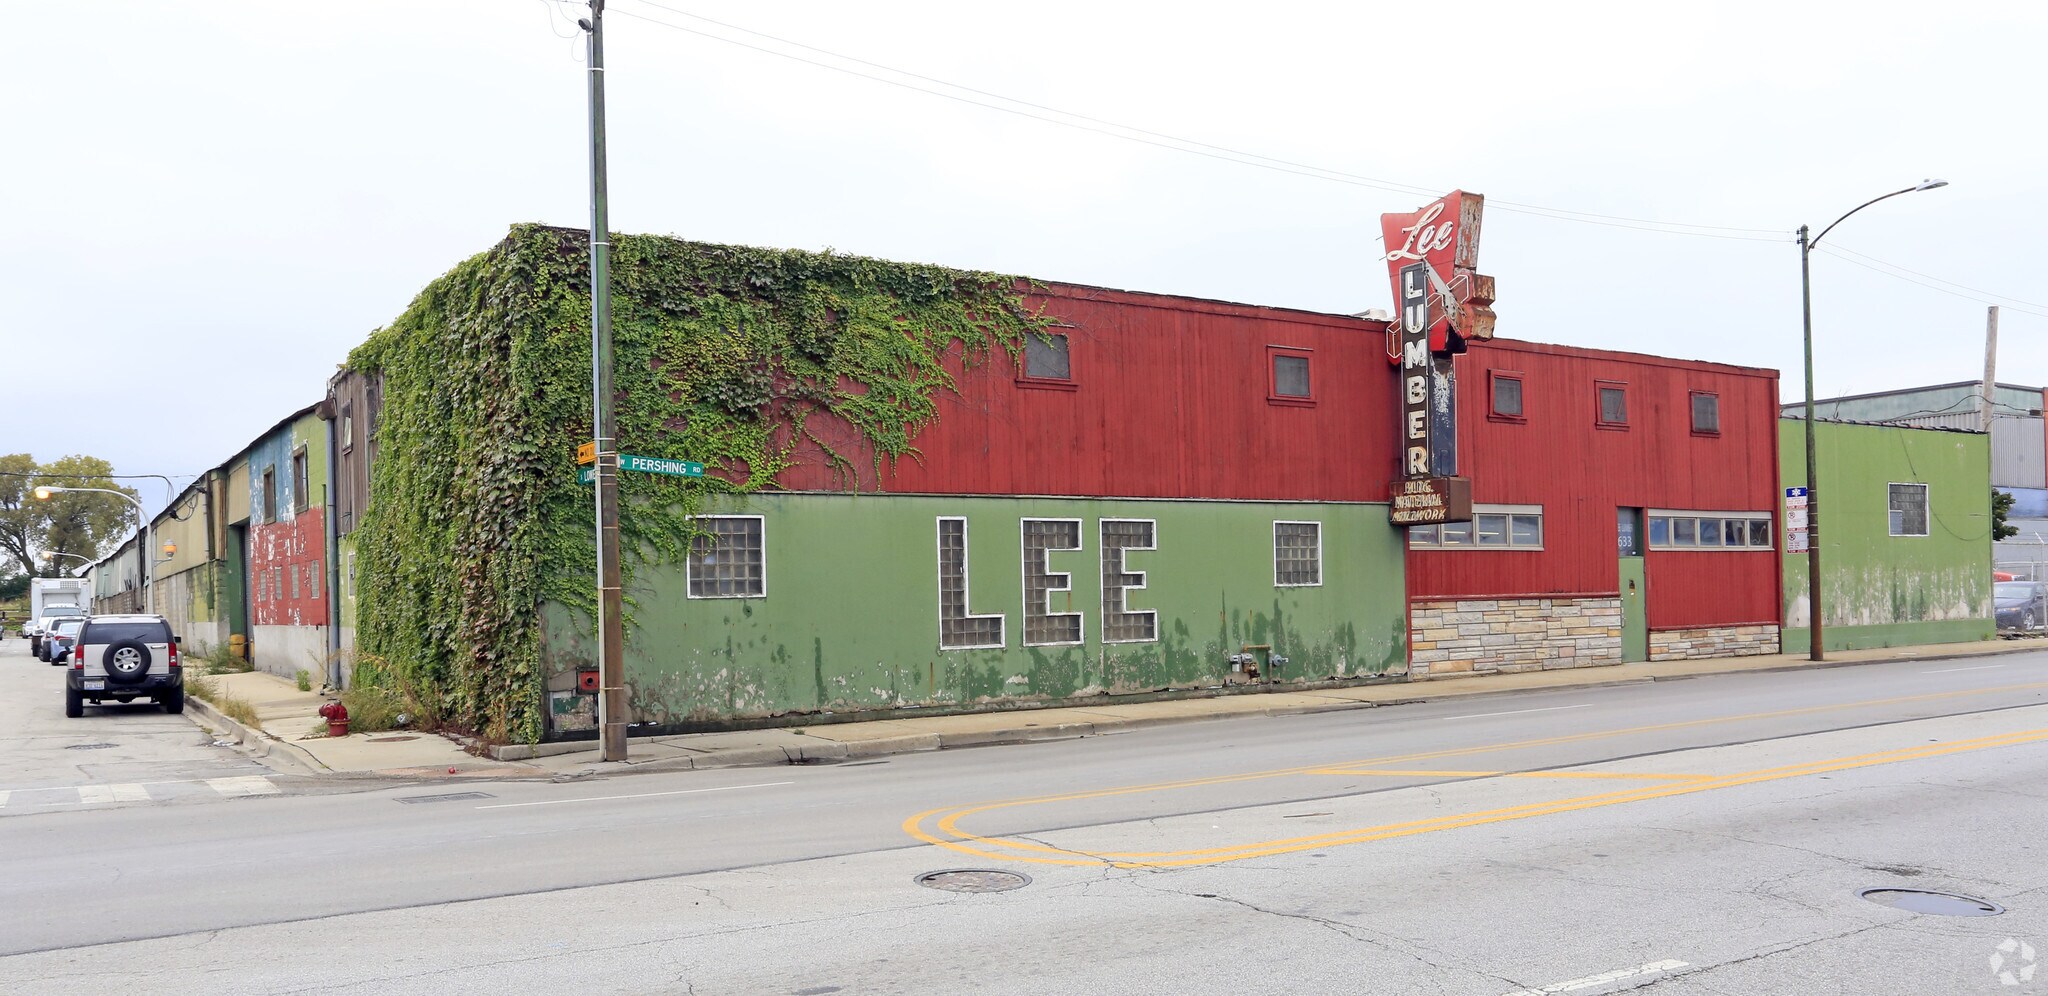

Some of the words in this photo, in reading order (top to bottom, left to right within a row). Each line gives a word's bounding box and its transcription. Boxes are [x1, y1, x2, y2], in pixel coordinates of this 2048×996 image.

[1387, 202, 1454, 261] Lee
[1404, 271, 1428, 475] LUMBER
[632, 457, 687, 474] PERSHING
[1617, 536, 1632, 547] 633
[936, 516, 1158, 650] LEE
